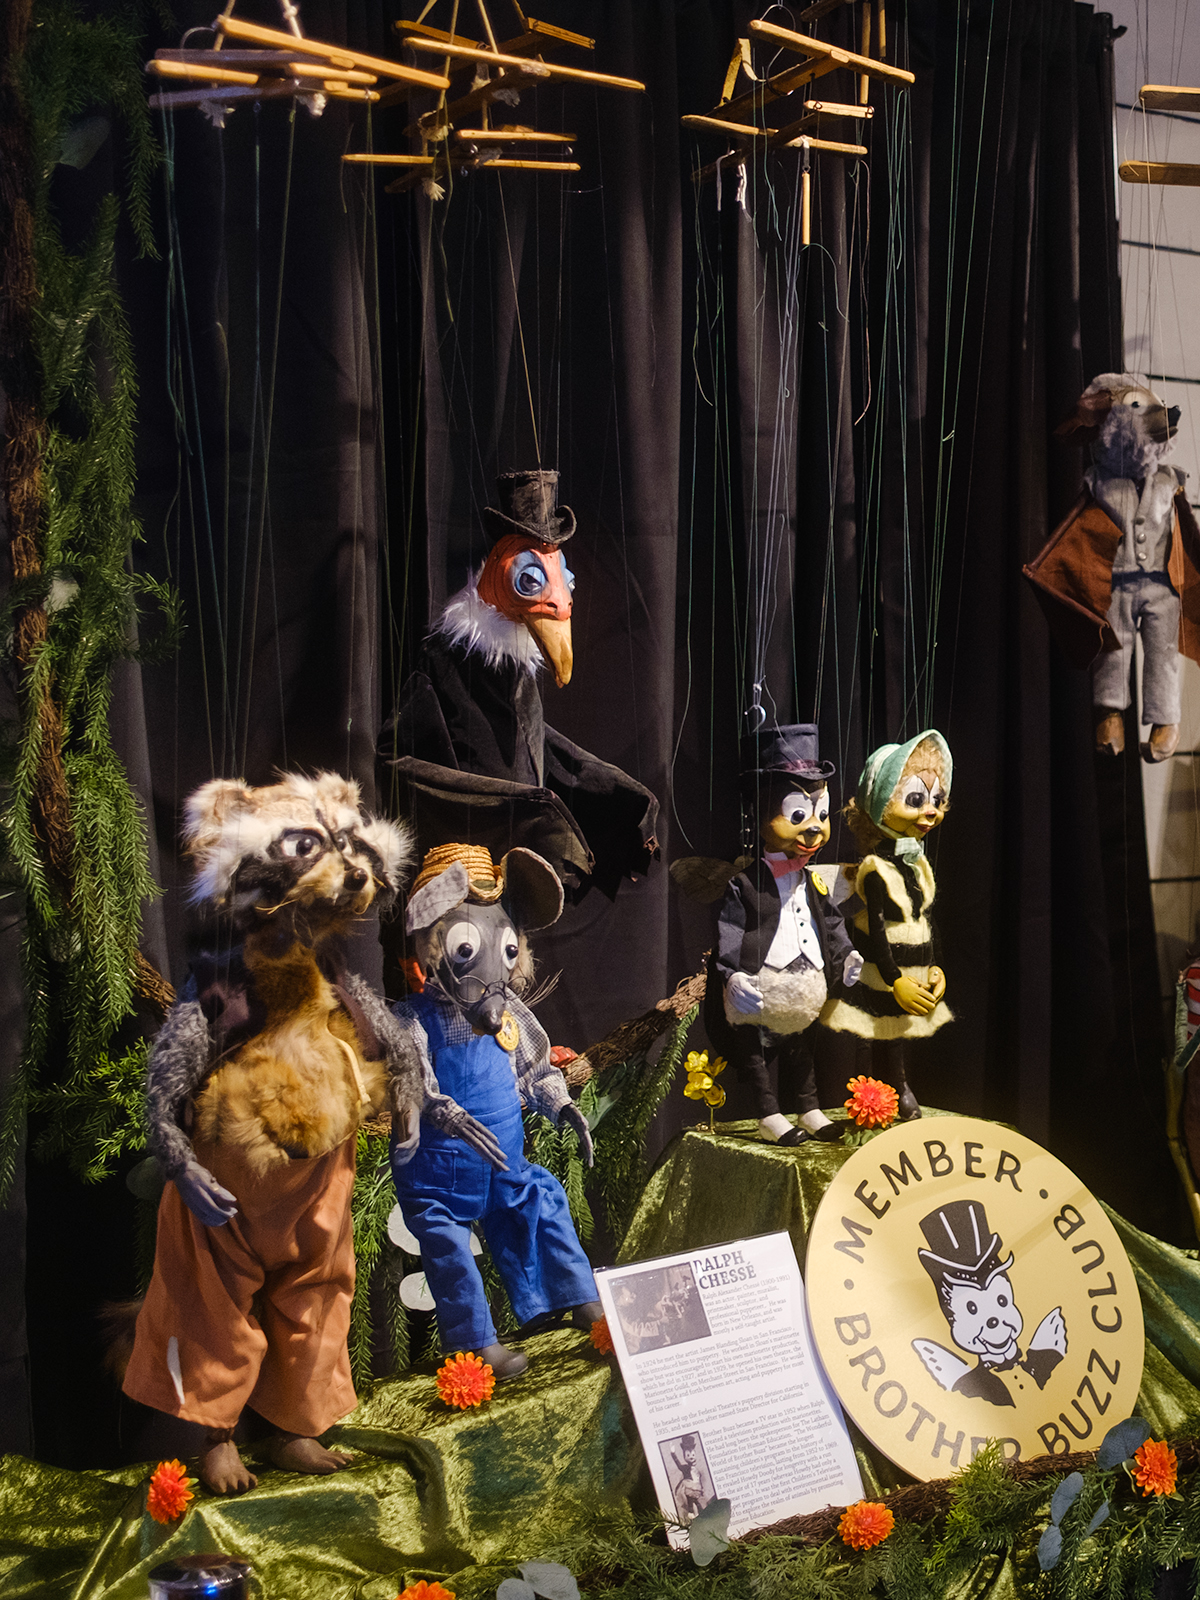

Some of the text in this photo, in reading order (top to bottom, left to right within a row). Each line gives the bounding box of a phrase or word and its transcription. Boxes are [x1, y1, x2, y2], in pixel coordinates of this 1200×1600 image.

[833, 1139, 1023, 1264] MEMBER
[693, 1250, 746, 1273] RALPH
[699, 1261, 757, 1290] CHESSÉ
[1052, 1204, 1122, 1333] CLUB
[1037, 1348, 1121, 1456] BUZZ
